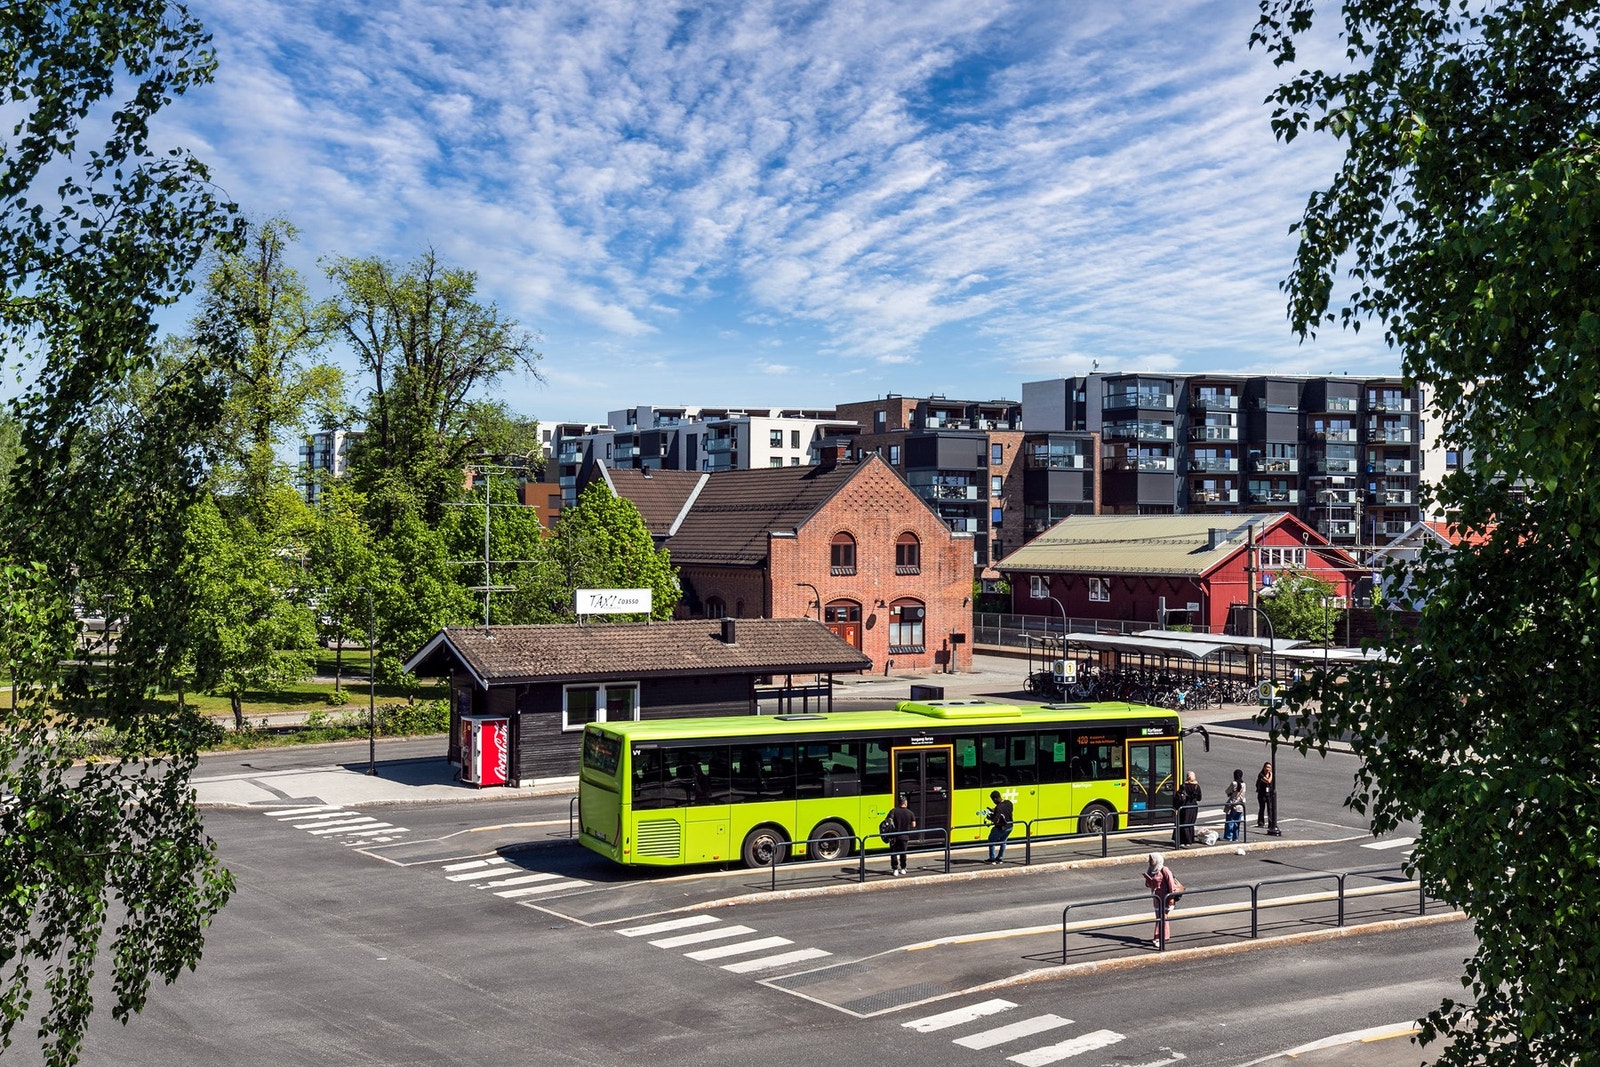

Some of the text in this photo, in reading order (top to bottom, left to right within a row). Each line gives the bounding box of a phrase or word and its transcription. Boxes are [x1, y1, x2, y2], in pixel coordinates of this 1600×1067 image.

[1375, 573, 1380, 581] 2
[1263, 685, 1268, 694] 2
[1077, 736, 1088, 744] 420
